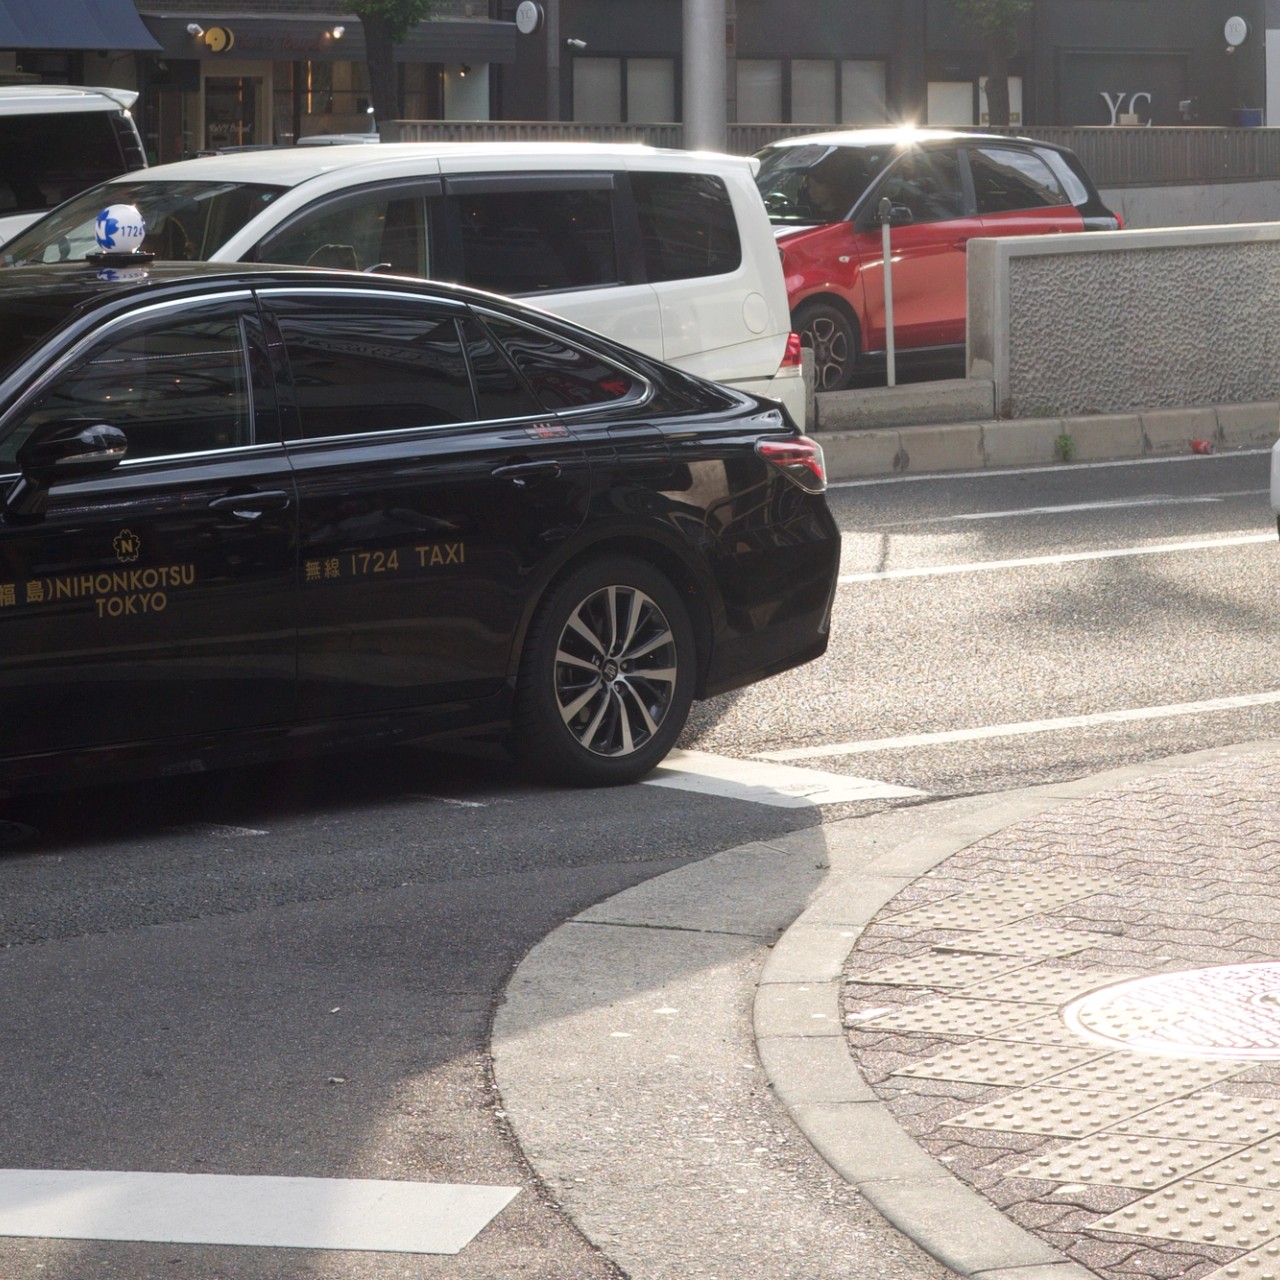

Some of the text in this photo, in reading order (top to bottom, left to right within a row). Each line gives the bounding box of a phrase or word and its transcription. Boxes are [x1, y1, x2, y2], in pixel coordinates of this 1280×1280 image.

[1099, 91, 1152, 128] YC
[305, 542, 465, 581] 無線 1724 TAXI
[95, 590, 168, 618] TOKYO
